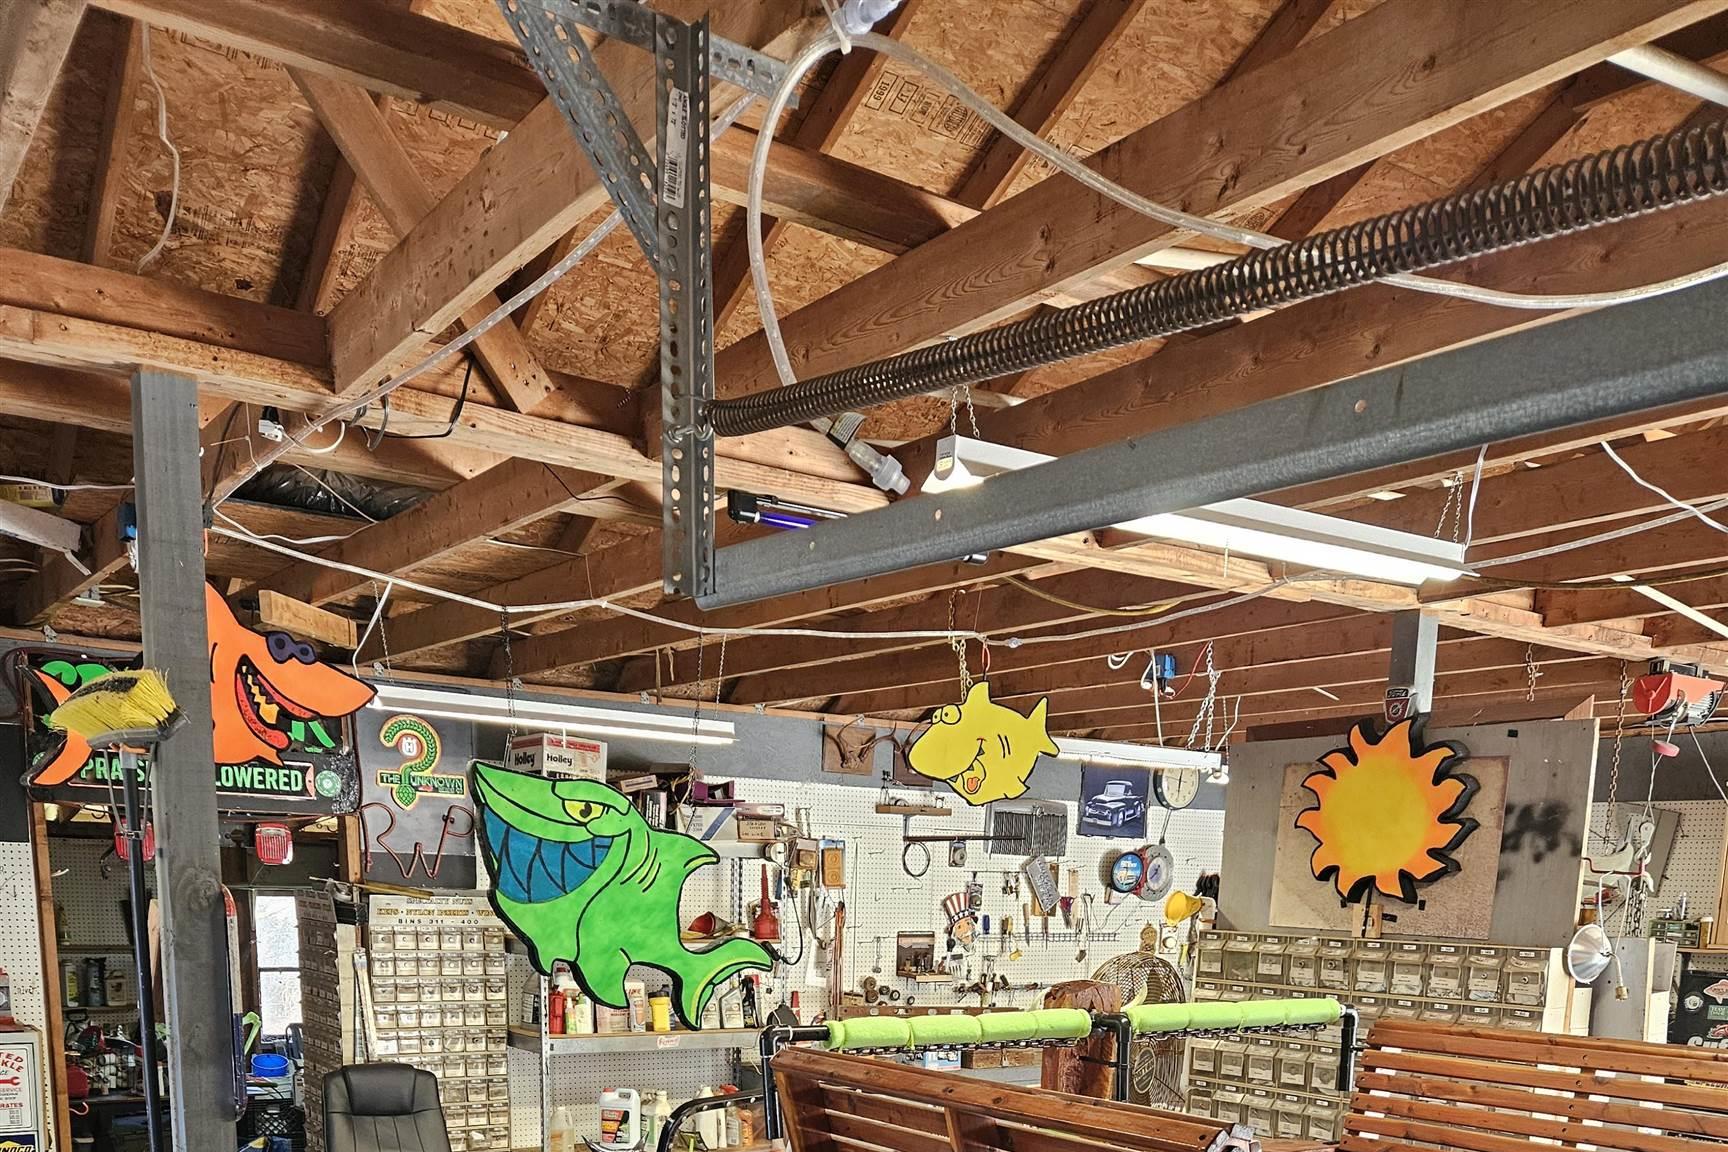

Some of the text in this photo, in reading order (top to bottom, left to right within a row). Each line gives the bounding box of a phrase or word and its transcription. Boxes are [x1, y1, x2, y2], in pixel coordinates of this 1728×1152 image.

[514, 752, 573, 767] Holley Holley
[80, 757, 152, 782] PRAS
[381, 773, 463, 789] THE UNKNOWN
